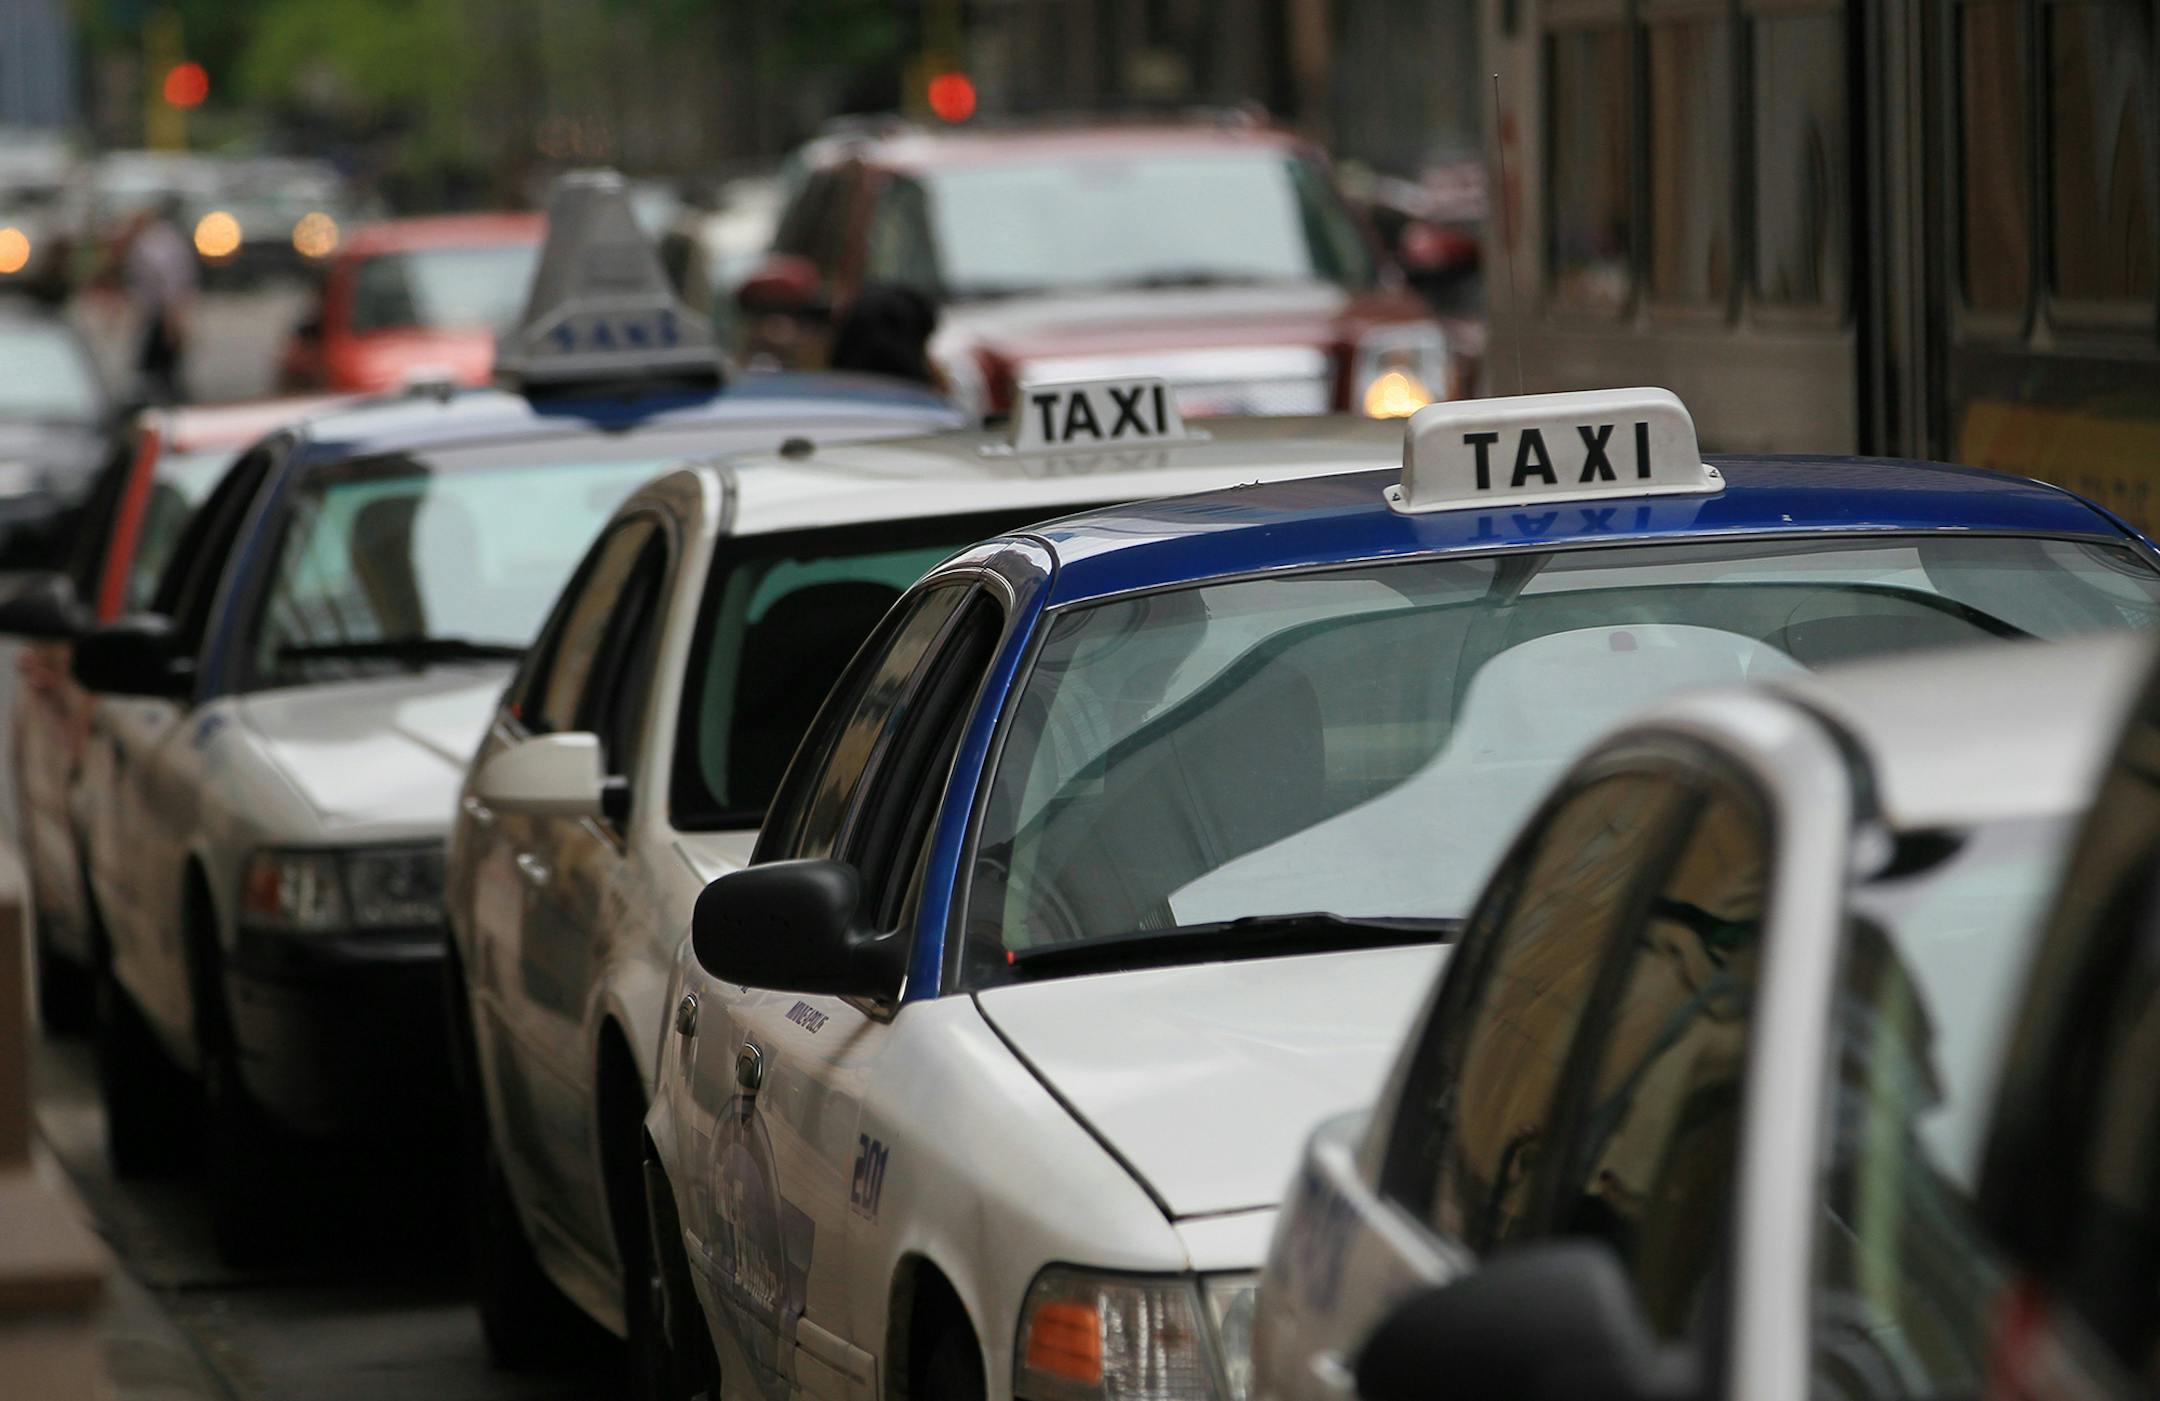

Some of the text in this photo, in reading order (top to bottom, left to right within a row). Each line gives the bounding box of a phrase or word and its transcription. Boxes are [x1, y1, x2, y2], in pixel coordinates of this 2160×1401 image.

[1032, 385, 1167, 441] TAXI
[1464, 422, 1651, 490] TAXI
[851, 1133, 889, 1216] 201
